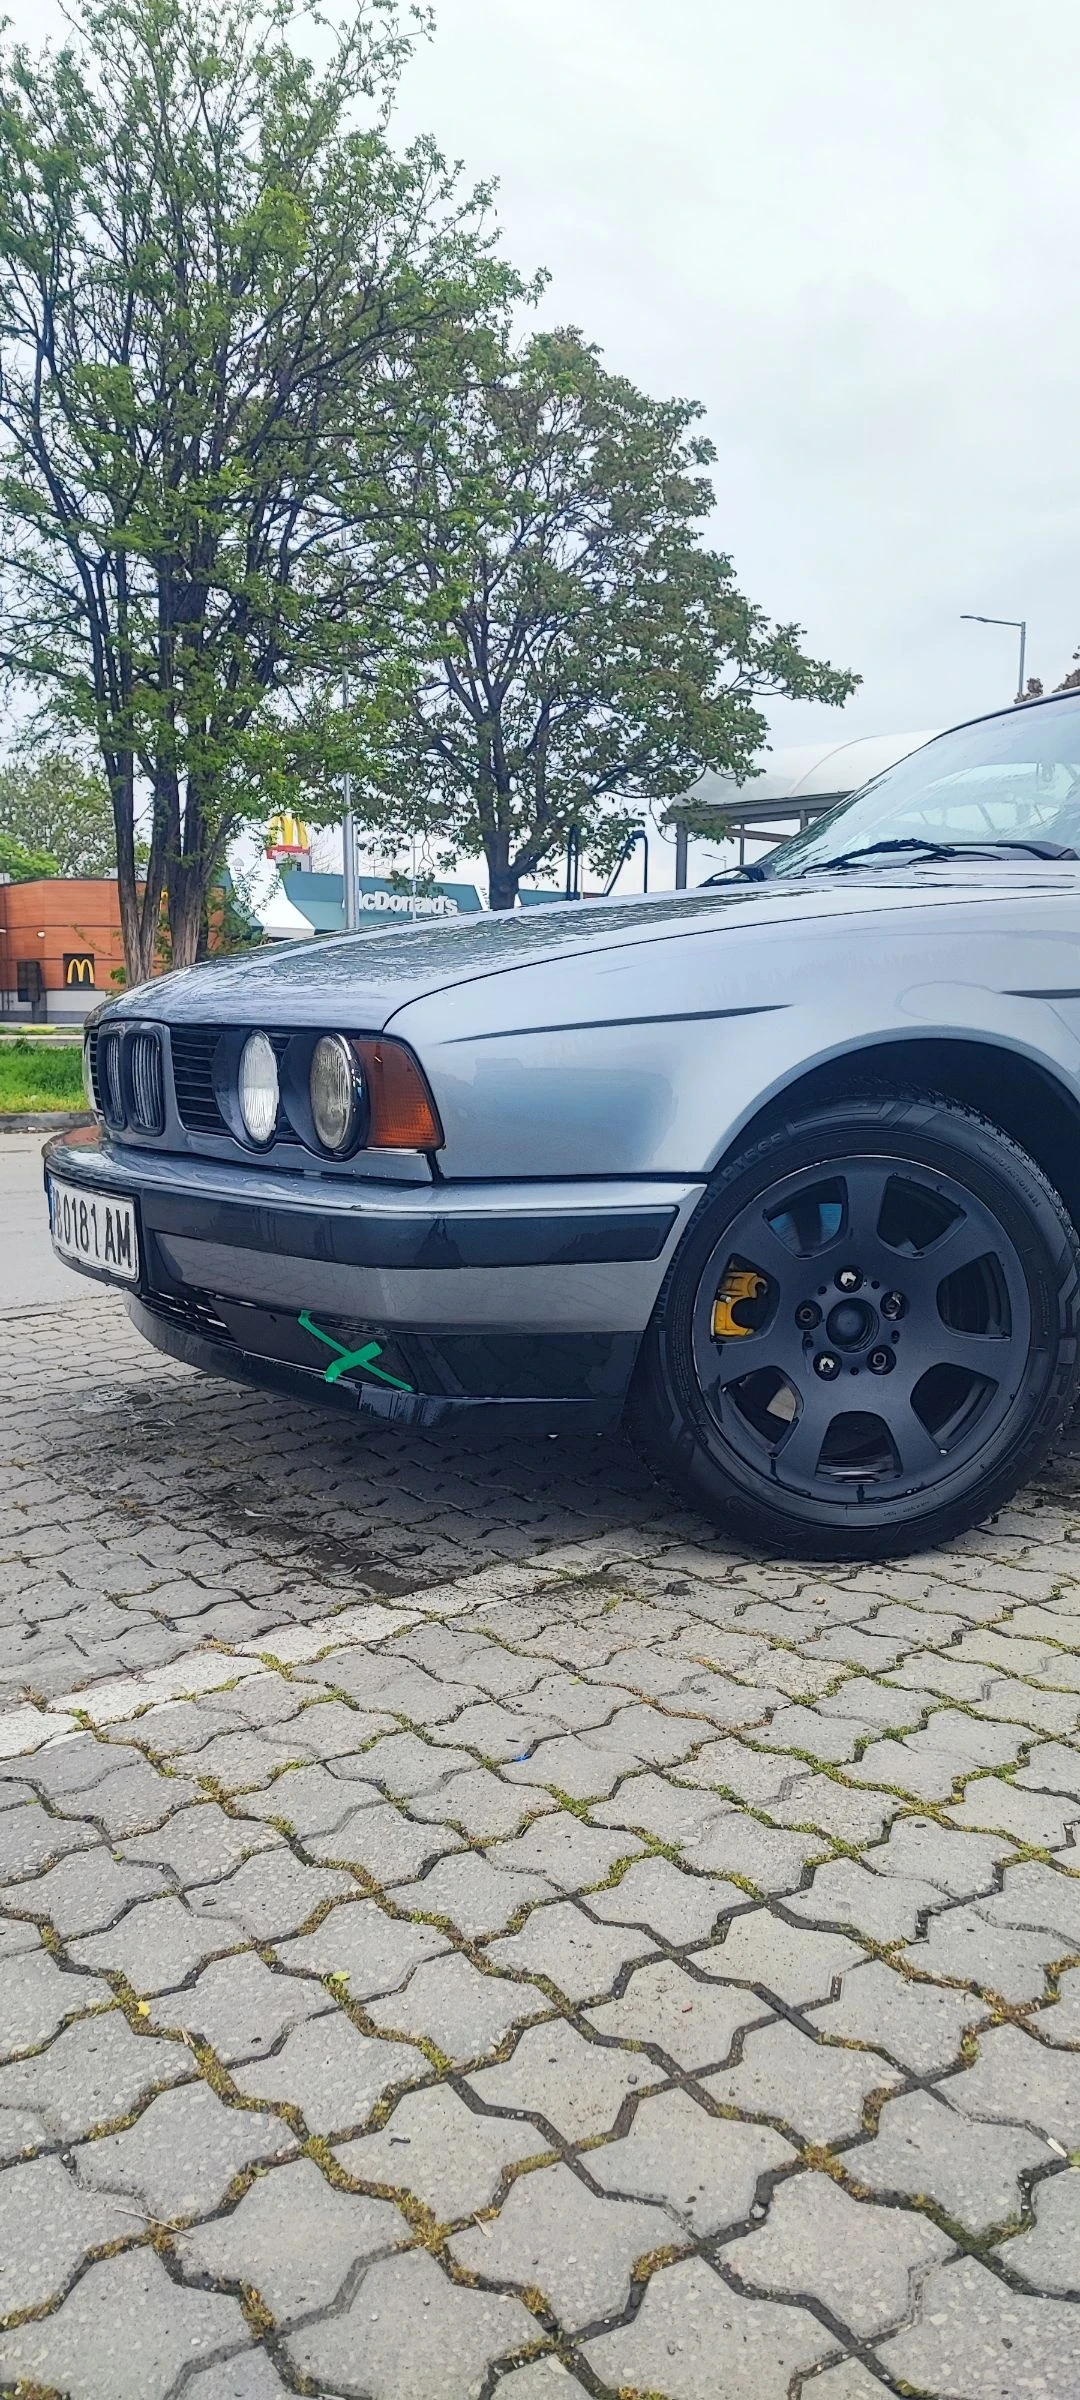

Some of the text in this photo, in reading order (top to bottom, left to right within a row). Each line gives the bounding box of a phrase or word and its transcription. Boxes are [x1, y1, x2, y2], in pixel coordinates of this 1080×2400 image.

[342, 889, 458, 915] cDonald's
[67, 958, 95, 984] M
[63, 1193, 100, 1258] 0181
[104, 1206, 132, 1269] AM
